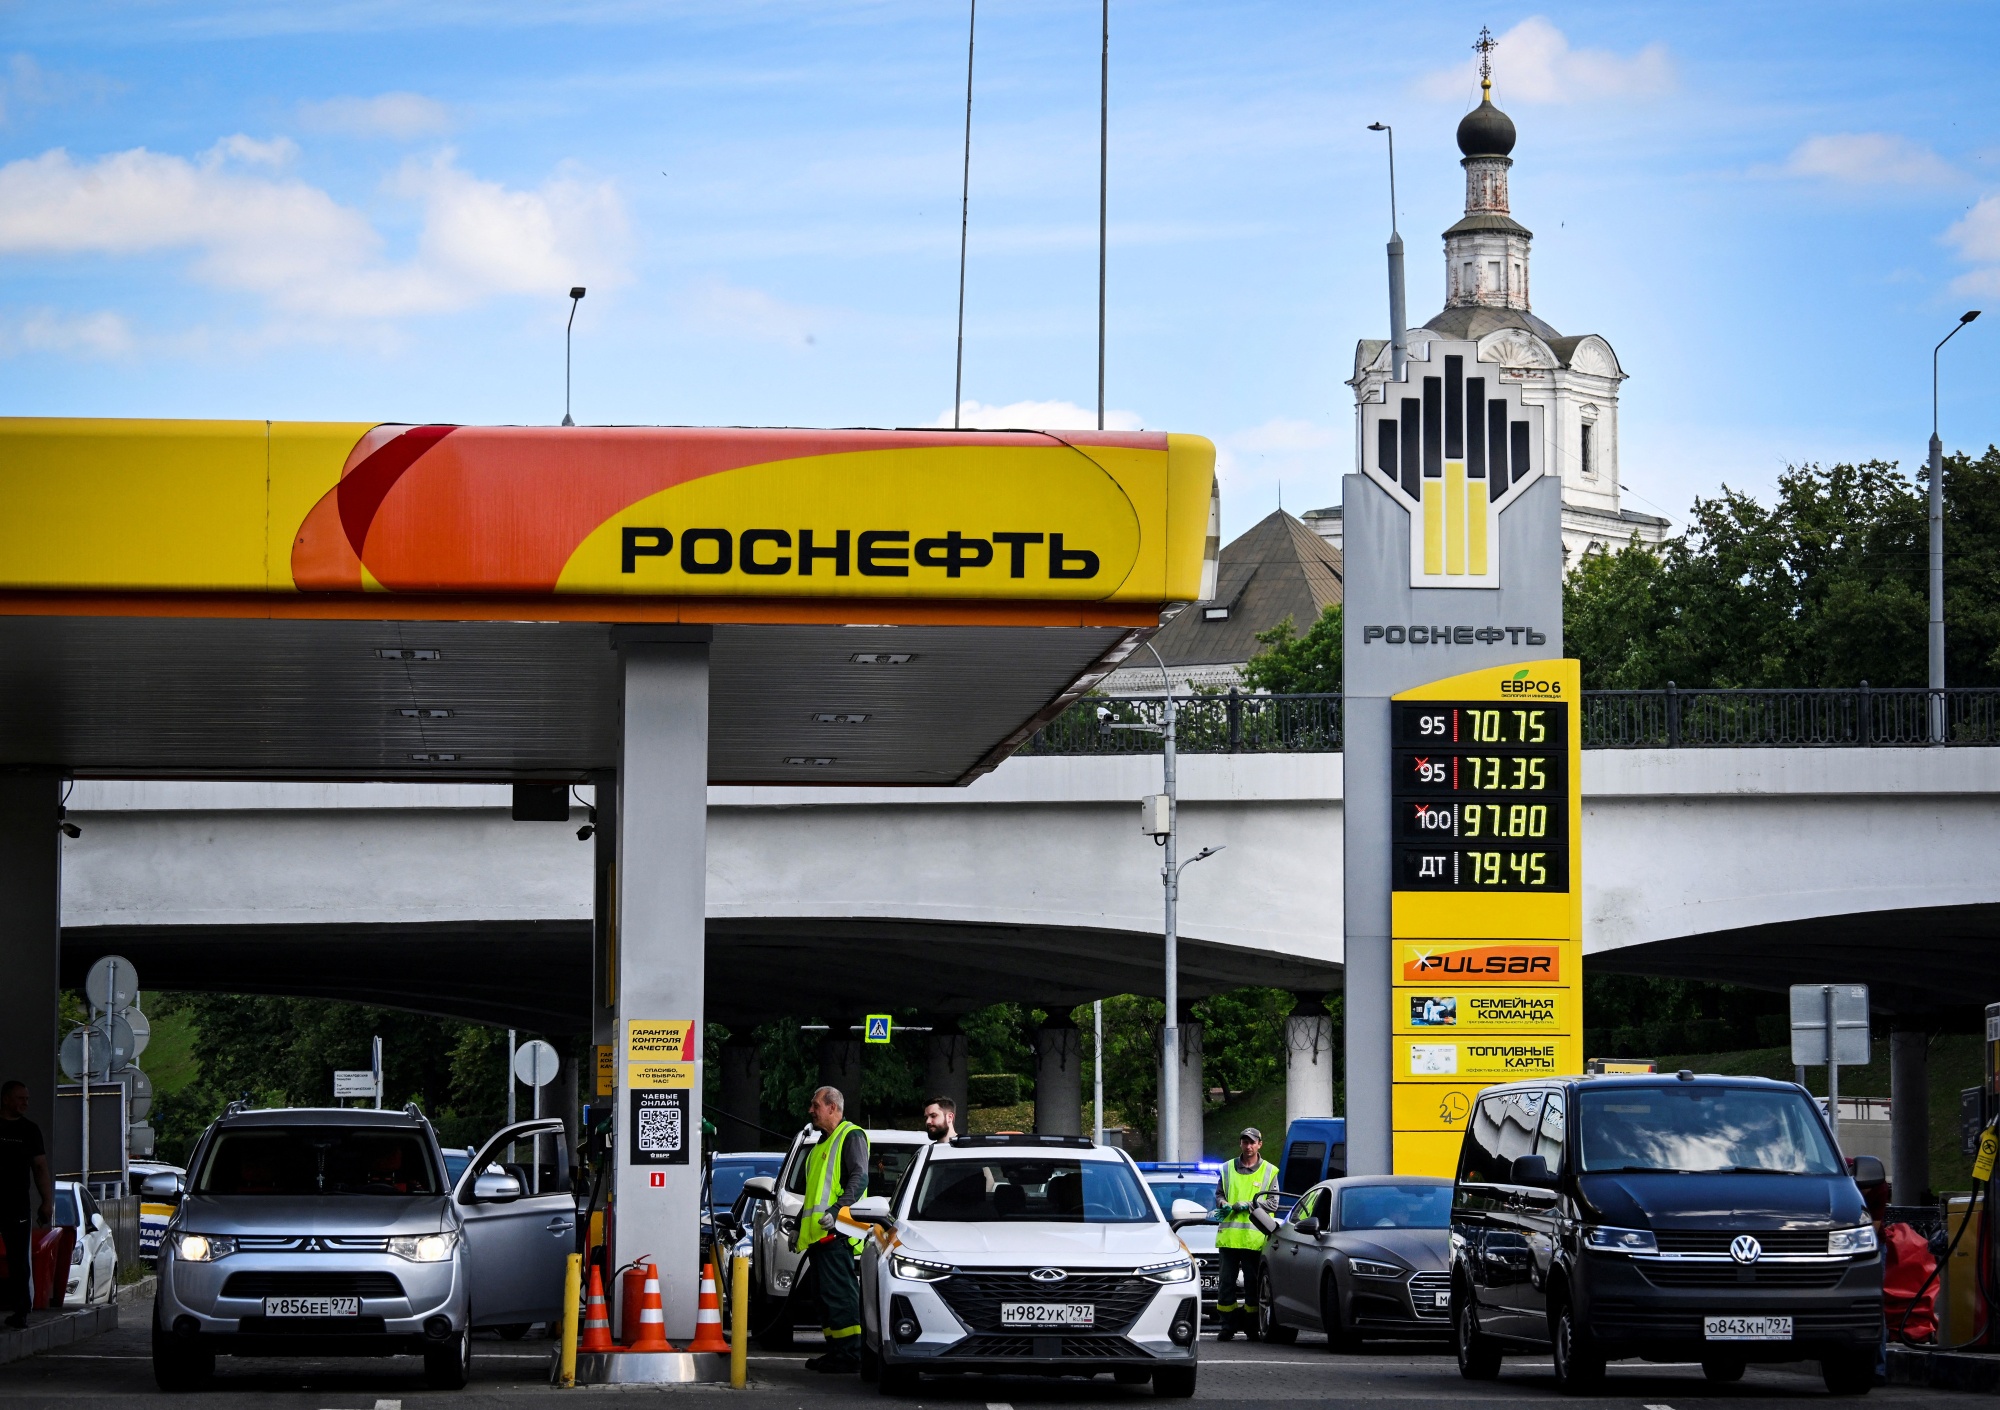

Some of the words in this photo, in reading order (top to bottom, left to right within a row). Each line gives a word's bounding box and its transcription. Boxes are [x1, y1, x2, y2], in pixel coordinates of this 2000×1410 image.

[621, 527, 1100, 579] РОСНЕФТЬ
[1364, 625, 1546, 645] РОСНЕФТЬ
[1501, 680, 1549, 693] ЕВРО
[1552, 681, 1561, 693] 6
[1420, 716, 1446, 735] 95
[1466, 710, 1545, 743] 70.75
[1420, 763, 1446, 782] 95
[1466, 757, 1546, 790] 73.35
[1418, 810, 1451, 829] 100
[1464, 804, 1547, 837] 97.80
[1419, 856, 1446, 878] ДТ
[1466, 852, 1546, 885] 79.45
[1470, 997, 1554, 1009] СЕМЕЙНАЯ
[1478, 1010, 1554, 1021] КОМАНДА
[1467, 1046, 1554, 1056] ТОПЛИВНЫЕ
[1505, 1058, 1554, 1068] КАРТЫ
[640, 1099, 680, 1107] ОНЛАЙН
[271, 1299, 328, 1314] У856ЕЕ
[332, 1298, 354, 1310] 977
[1006, 1306, 1065, 1321] Н982УК
[1068, 1306, 1090, 1317] 797
[1708, 1319, 1764, 1333] О843КН
[1766, 1318, 1788, 1330] 797
